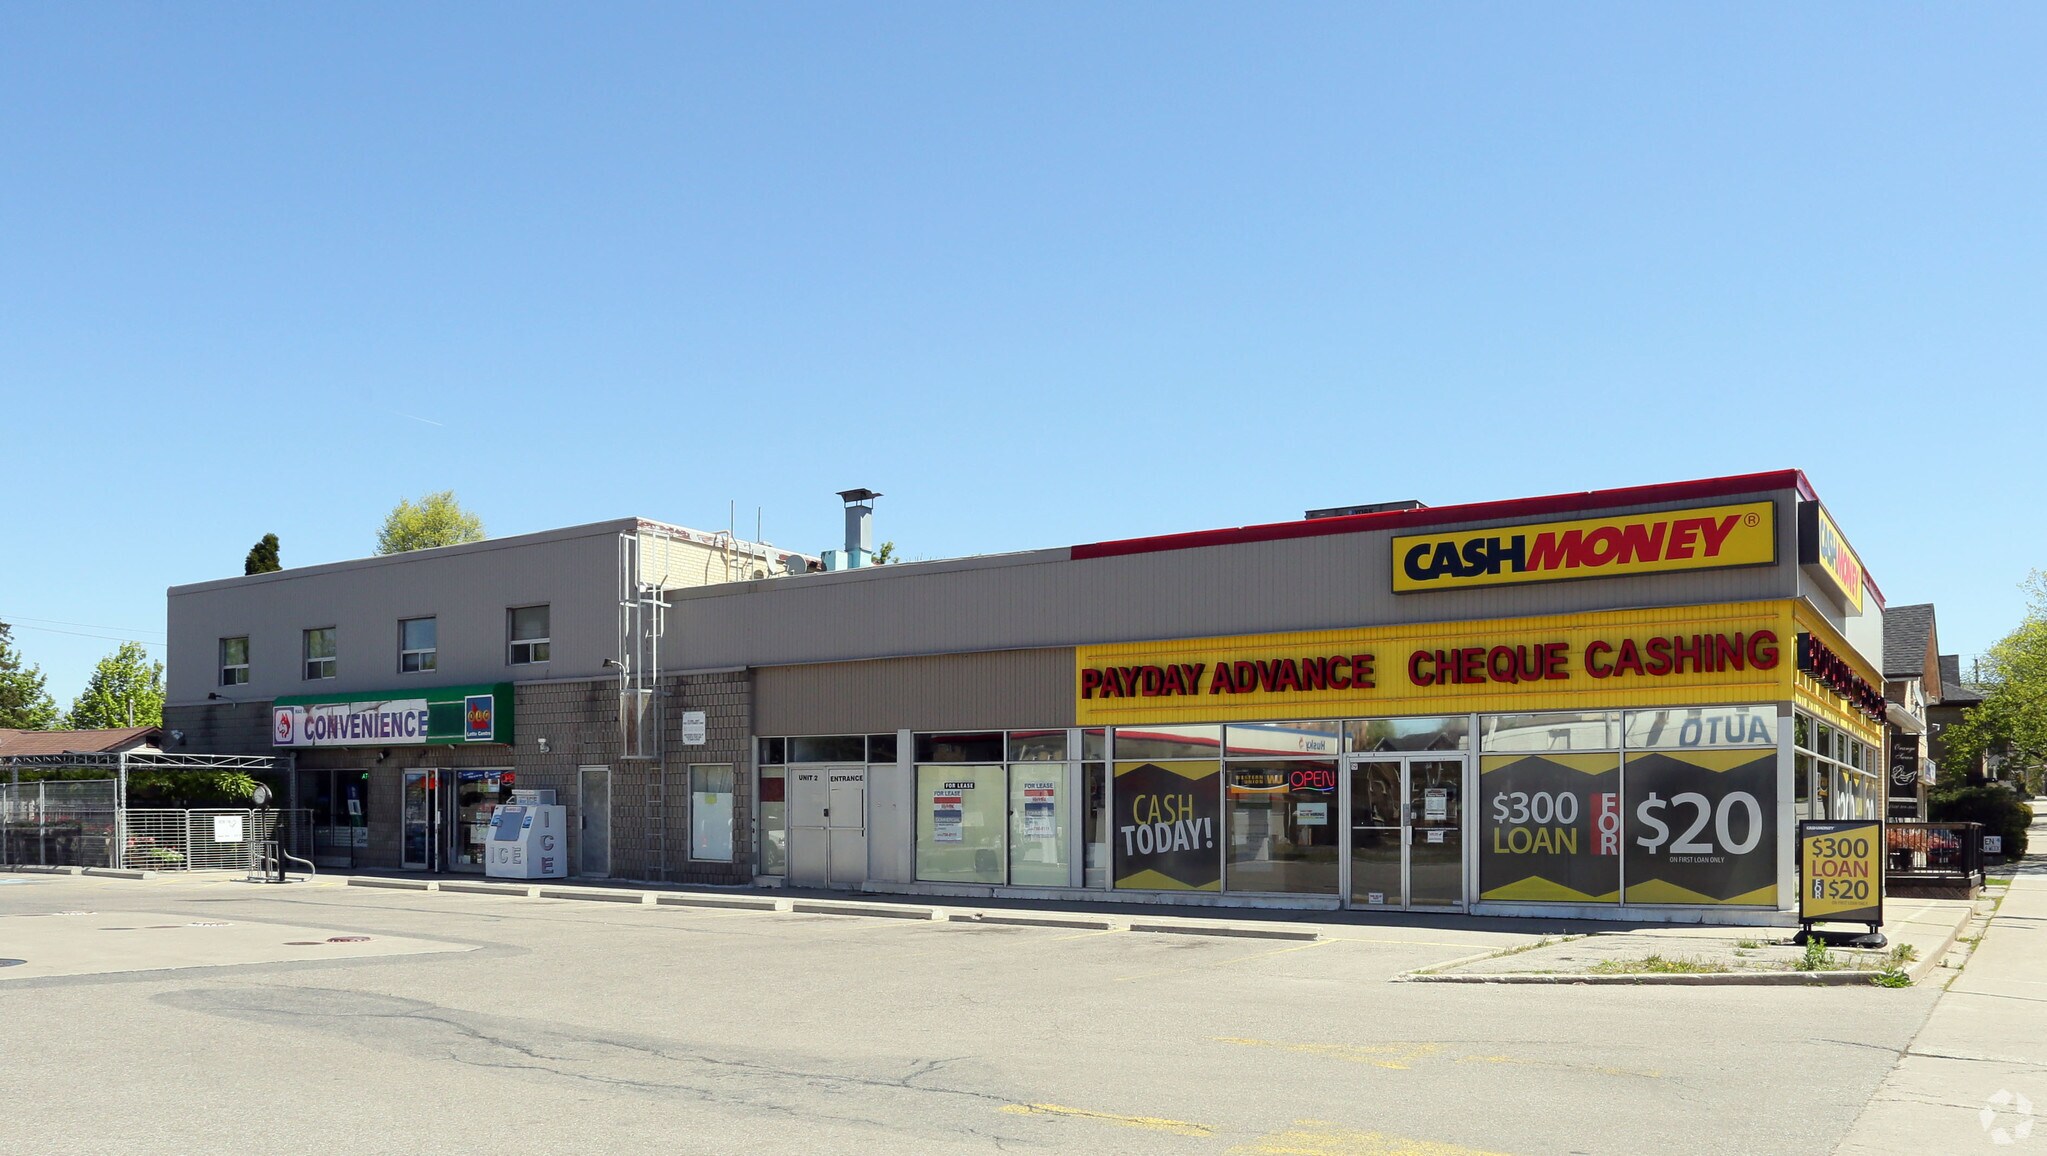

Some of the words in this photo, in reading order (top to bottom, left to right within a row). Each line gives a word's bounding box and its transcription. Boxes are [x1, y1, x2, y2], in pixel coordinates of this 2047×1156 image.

[1081, 663, 1205, 699] PAYDAY
[1209, 653, 1377, 695] ADVANCE
[1408, 642, 1571, 687] CHEQUE
[1584, 630, 1780, 679] CASHING
[304, 710, 428, 740] CONVENIENCE
[1291, 771, 1335, 787] OPEN
[1133, 794, 1194, 826] CASH
[1492, 791, 1579, 824] $300
[1597, 793, 1619, 855] FOR
[1636, 791, 1763, 855] $20
[1120, 817, 1213, 856] TODAY!
[1493, 827, 1577, 855] LOAN
[1812, 838, 1869, 858] $300
[490, 846, 522, 865] ICE
[1812, 860, 1868, 877] LOAN
[1814, 879, 1822, 899] FOR
[1829, 879, 1869, 900] $20
